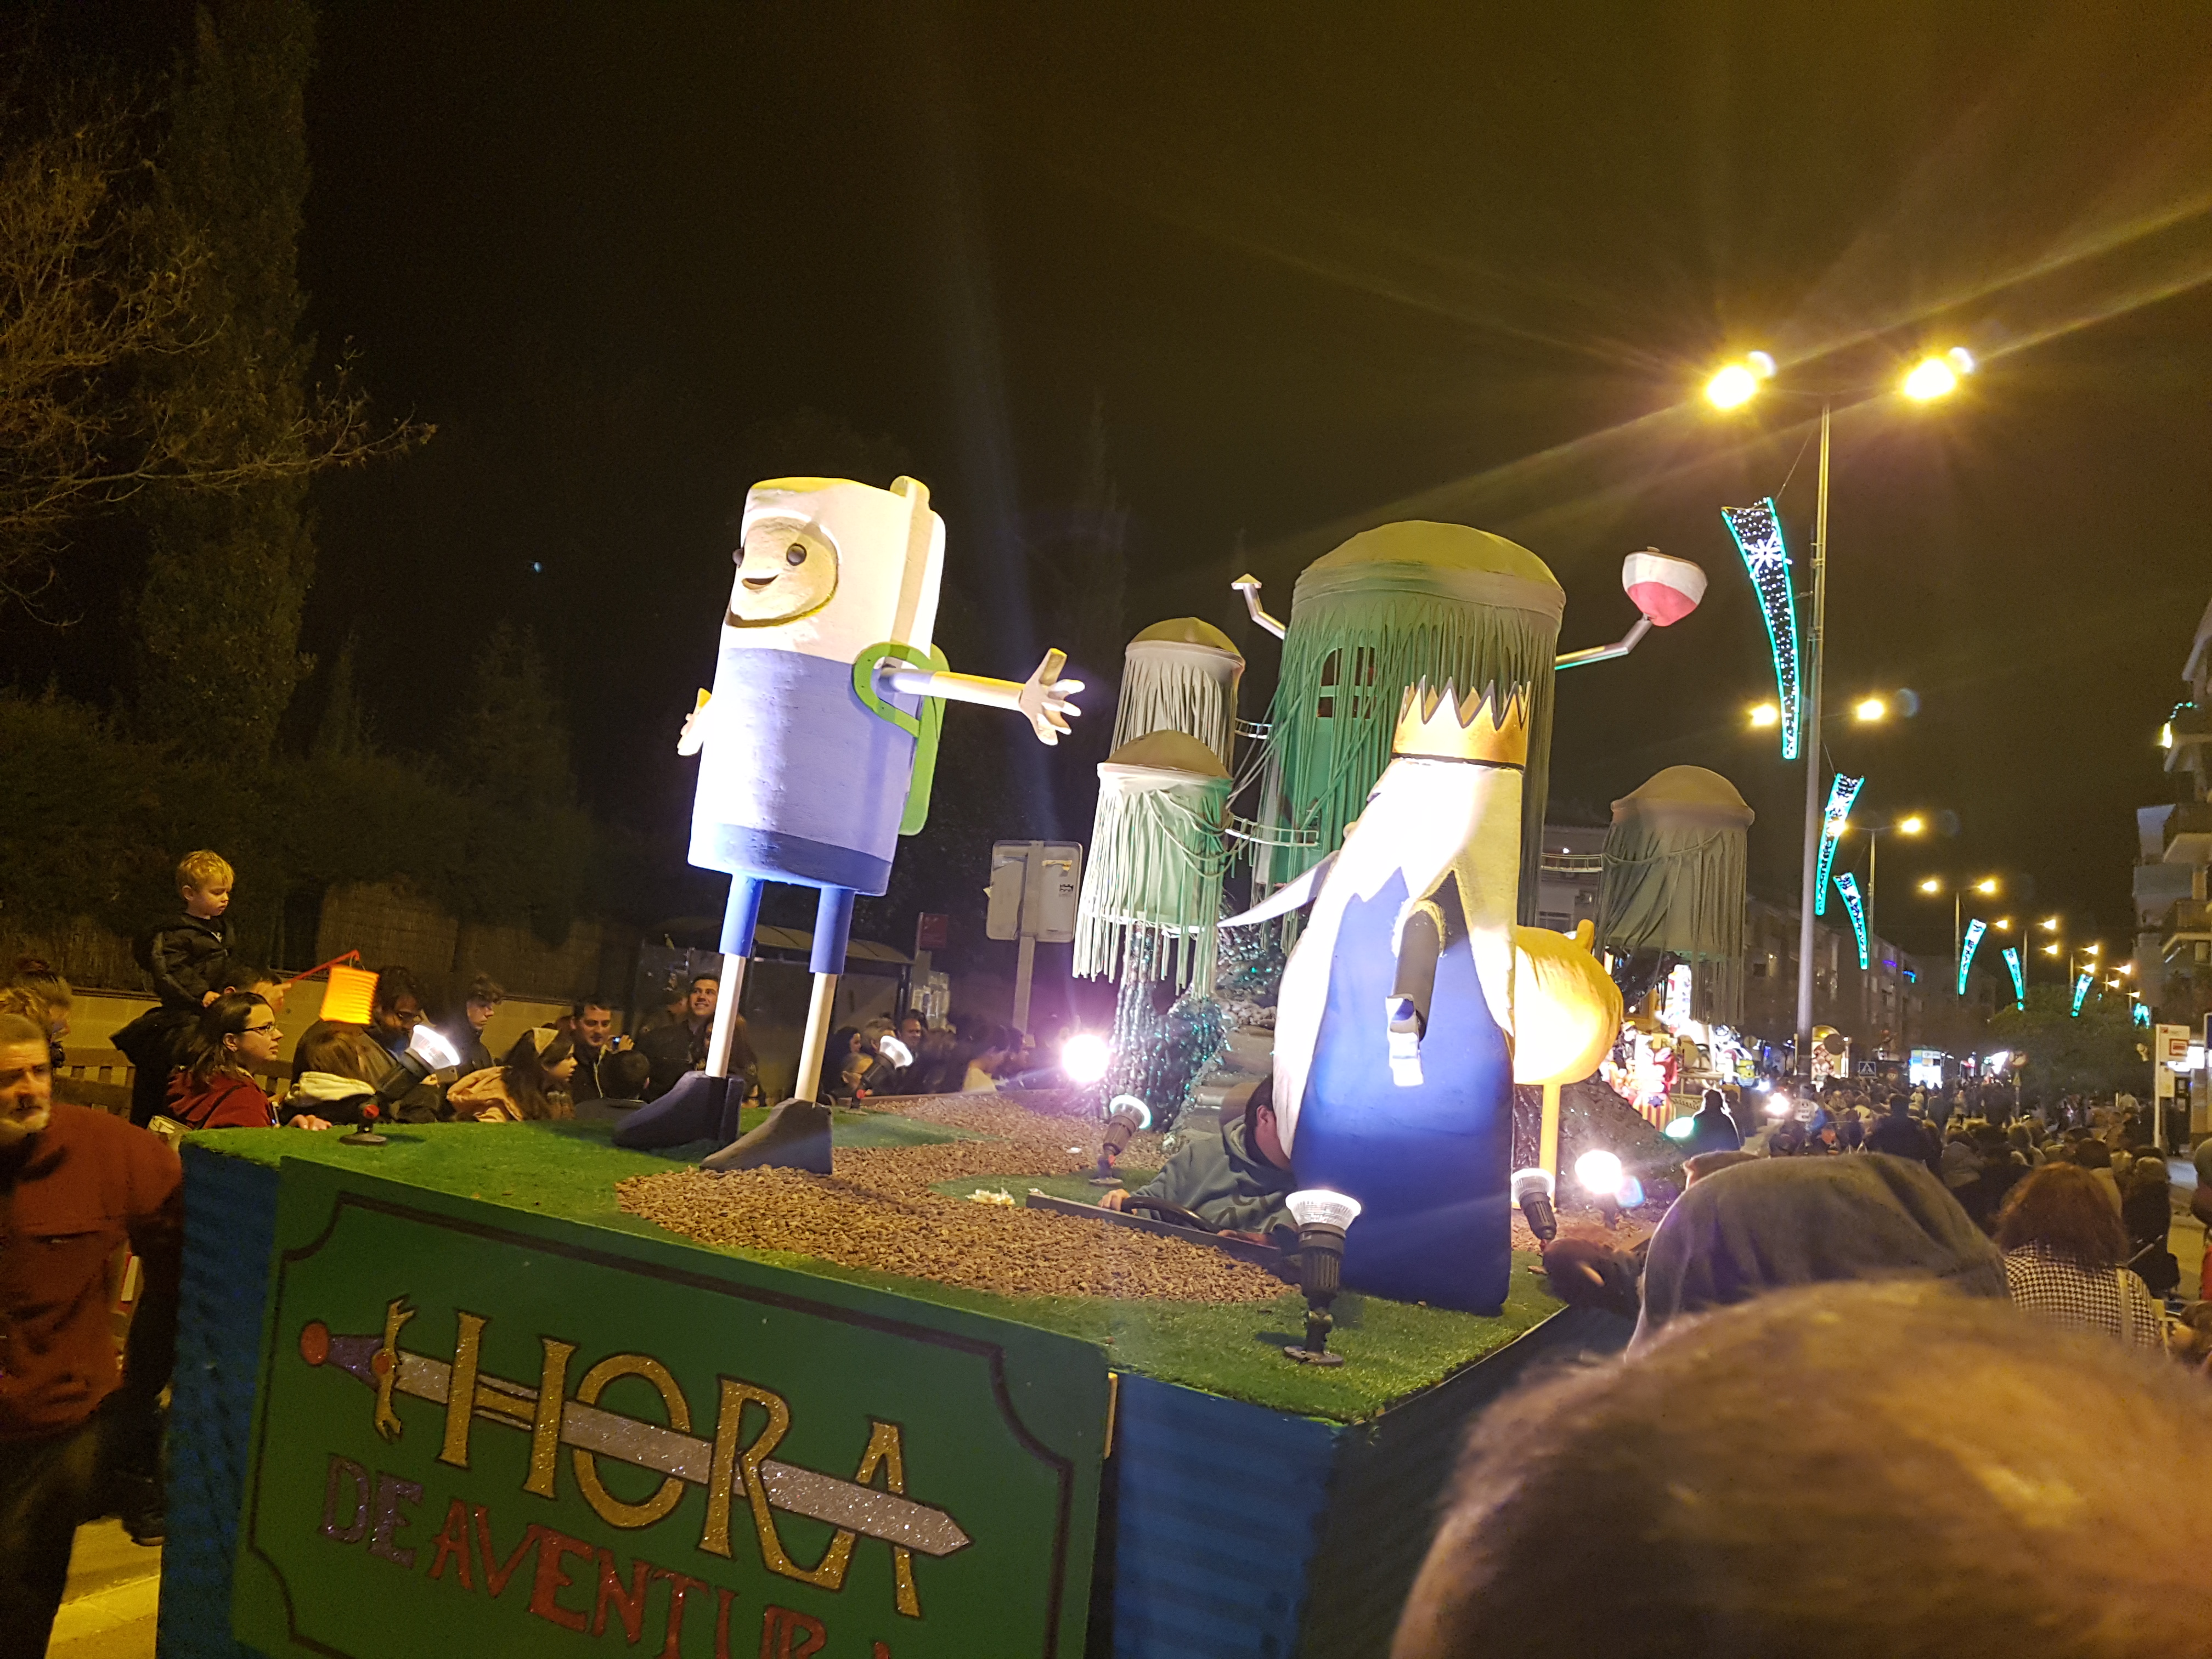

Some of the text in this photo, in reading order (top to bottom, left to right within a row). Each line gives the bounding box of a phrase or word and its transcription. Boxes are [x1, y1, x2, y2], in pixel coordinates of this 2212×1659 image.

[317, 1453, 892, 1659] DE AVENTUR
[437, 1310, 922, 1617] HORA
